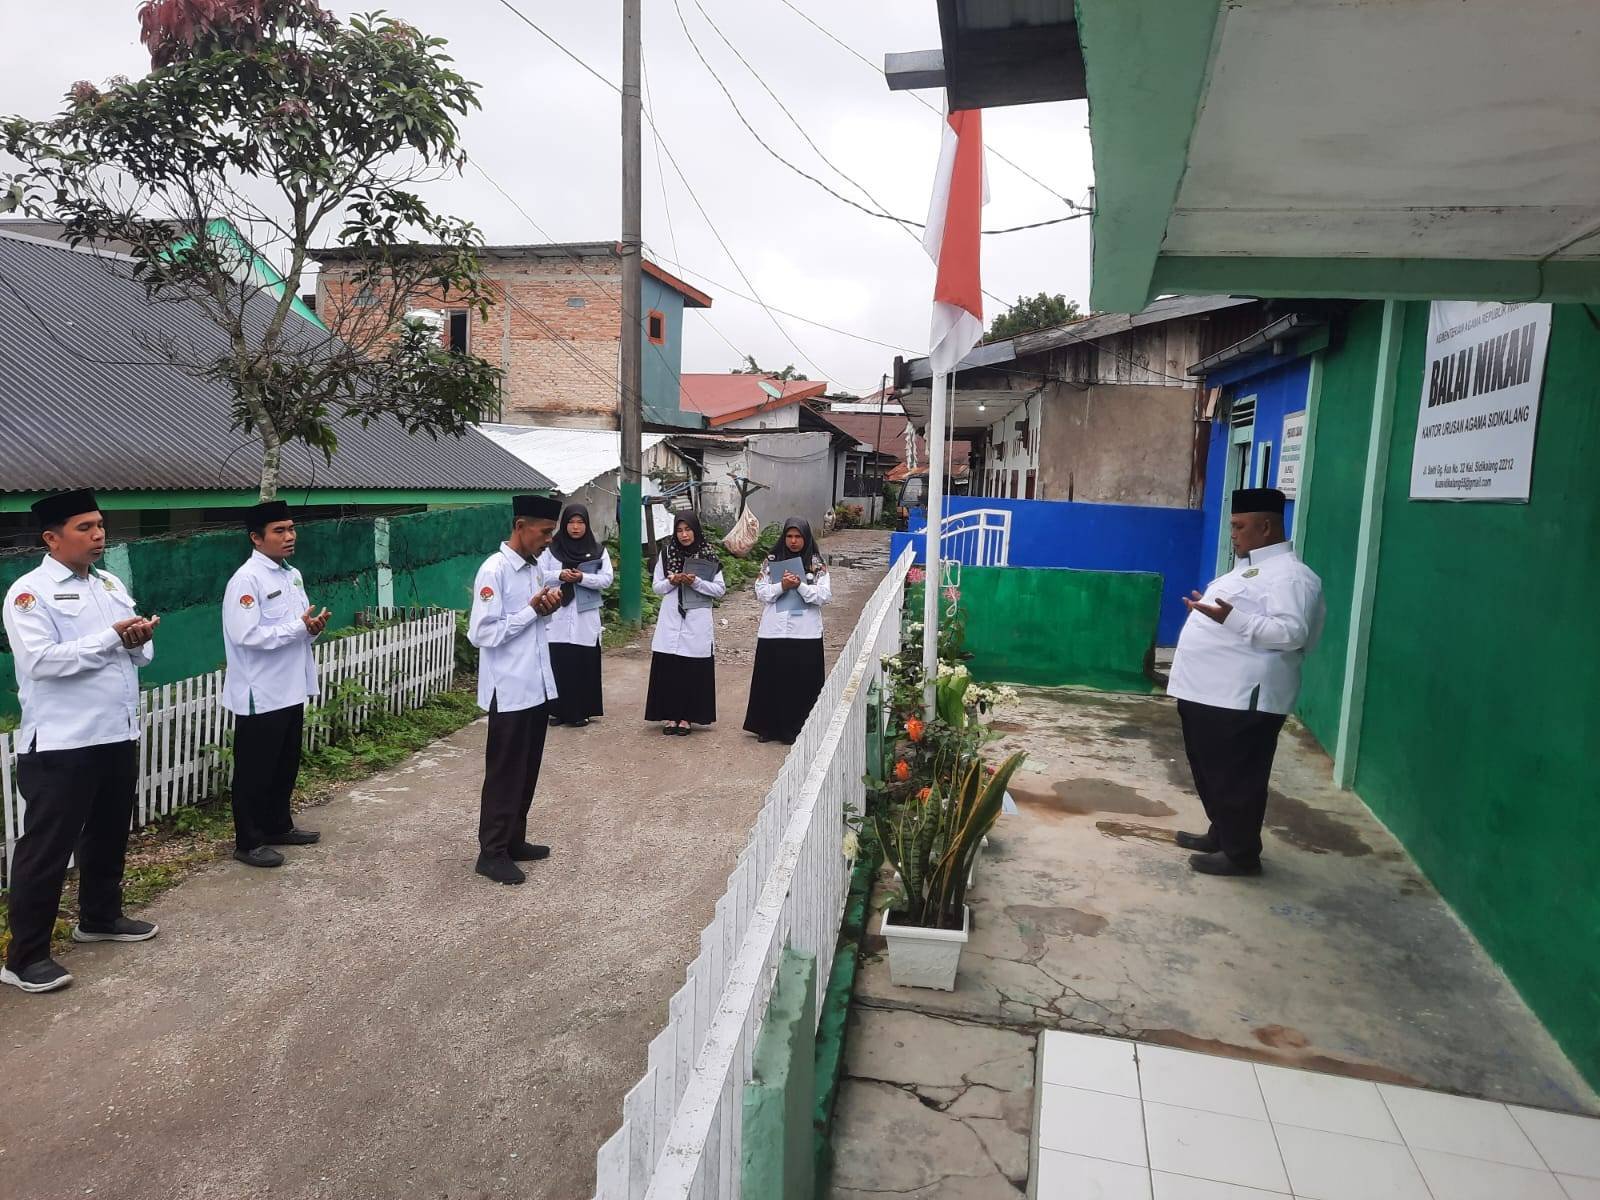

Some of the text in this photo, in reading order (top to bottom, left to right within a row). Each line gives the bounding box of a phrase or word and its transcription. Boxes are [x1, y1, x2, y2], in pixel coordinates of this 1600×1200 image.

[1428, 321, 1537, 409] BALAI NIKAH
[1422, 405, 1530, 439] KANTOR URUSAN AGAMA SIDIKALANG
